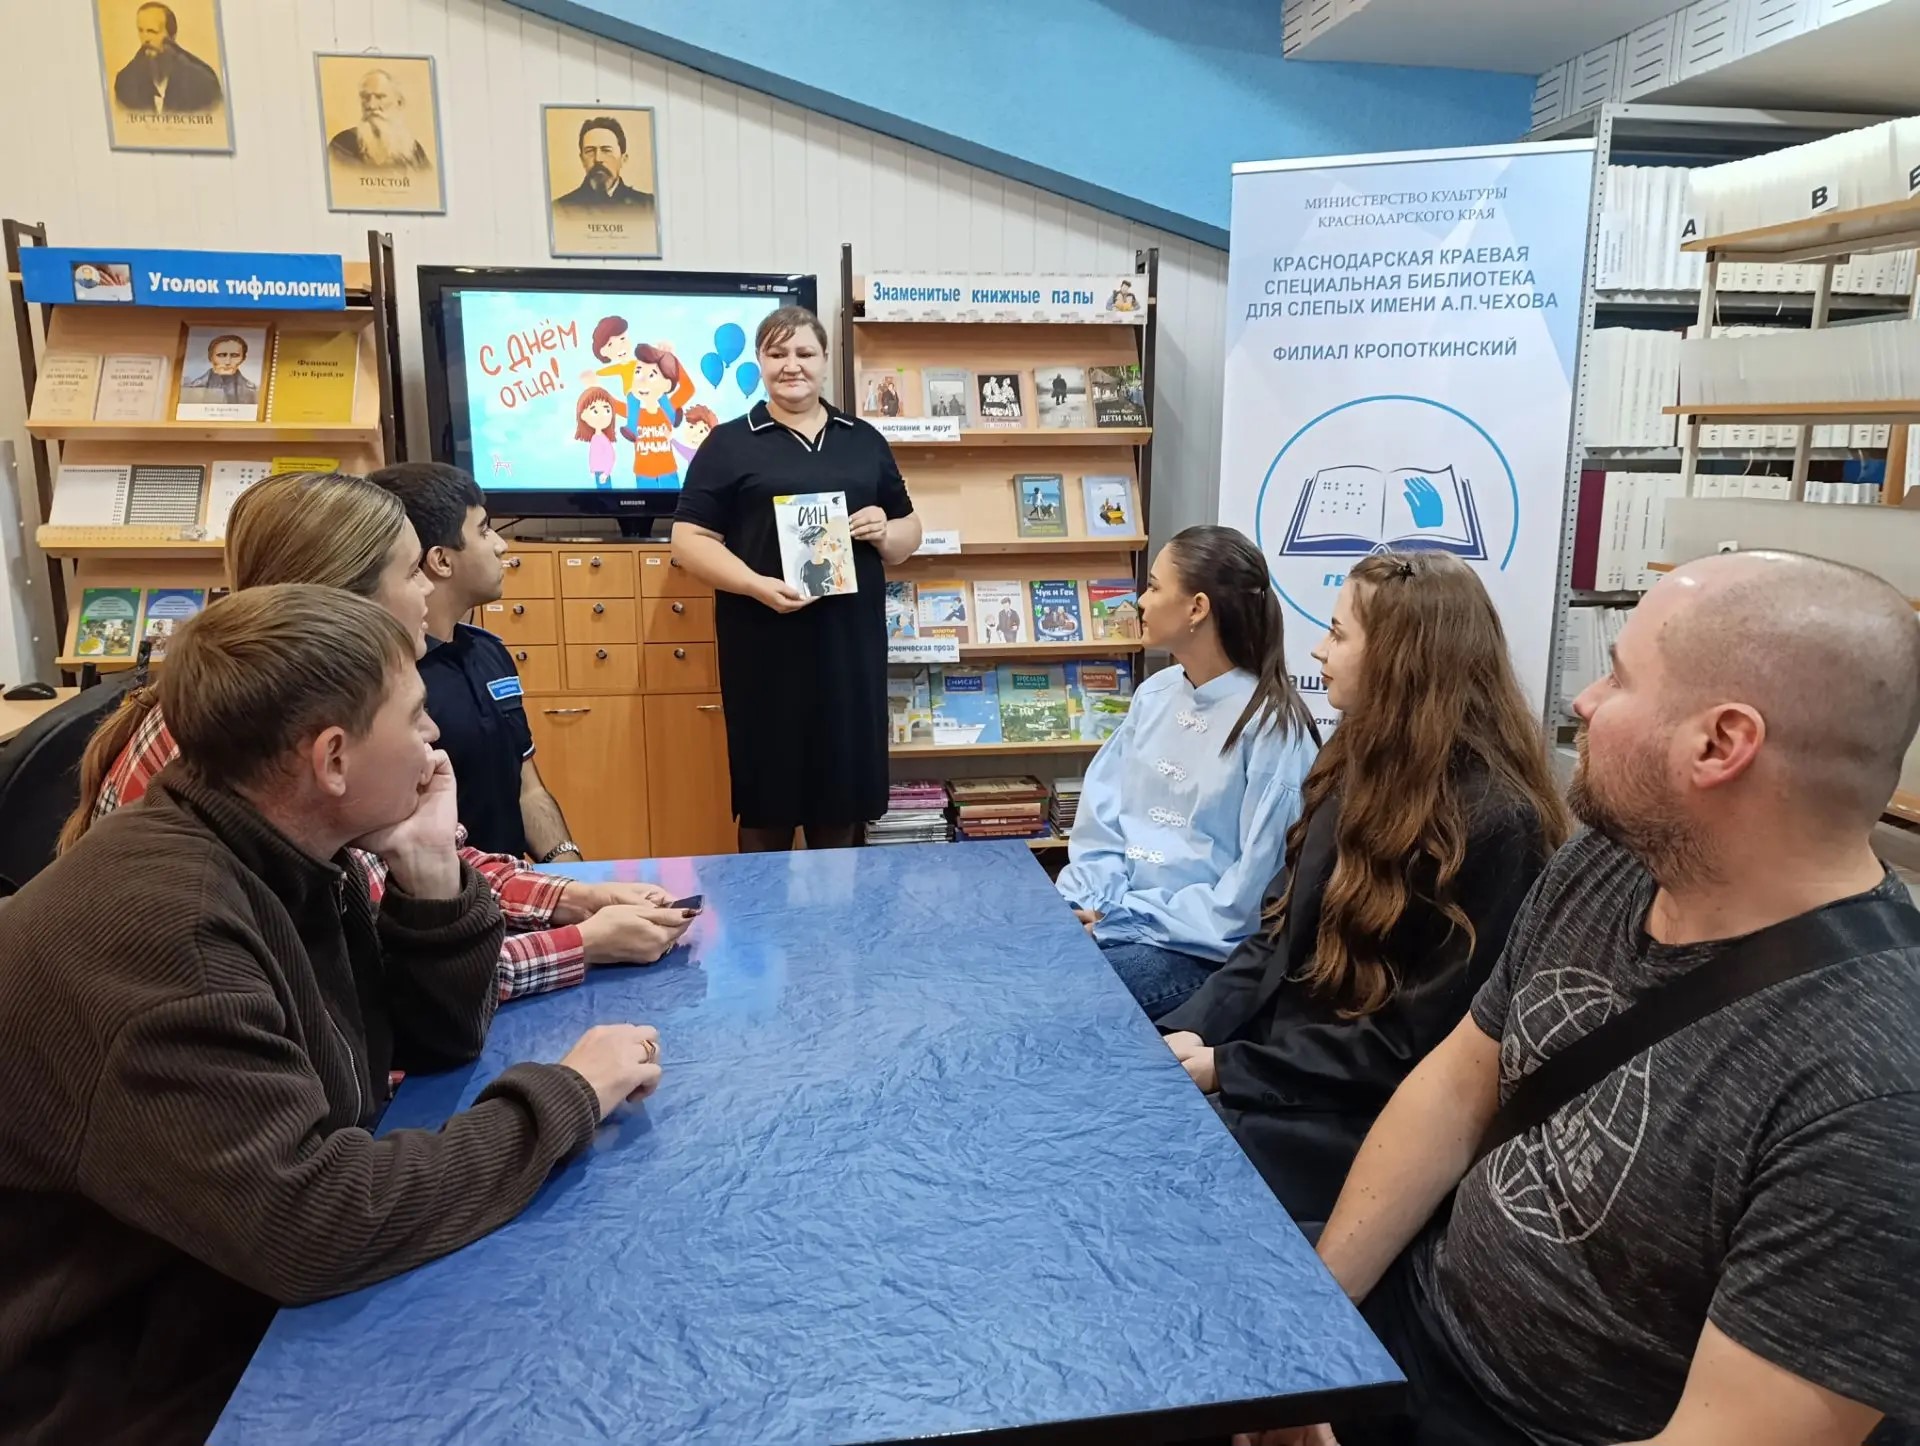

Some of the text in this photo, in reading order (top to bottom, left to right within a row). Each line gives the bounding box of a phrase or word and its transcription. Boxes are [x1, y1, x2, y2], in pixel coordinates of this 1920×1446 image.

[126, 112, 214, 125] ДОСТОЕВСКИЙ
[360, 176, 410, 187] ТОЛСТОЙ
[1304, 187, 1508, 210] МИНИСТЕРСТВО КУЛЬТУРЫ
[588, 223, 624, 232] ЧЕХОВ
[1318, 207, 1495, 228] КРАСНОДАРСКОГО КРАЯ
[1273, 246, 1529, 272] КРАСНОДАРСКАЯ КРАЕВАЯ
[148, 272, 341, 301] Уголок тифлологии
[873, 281, 961, 303] Знаменитые
[971, 287, 1041, 304] книжные
[1264, 269, 1536, 296] СПЕЦИАЛЬНАЯ БИБЛИОТЕКА
[1246, 302, 1282, 321] ДЛЯ
[1287, 298, 1365, 316] СЛЕПЫХ
[1371, 296, 1436, 313] ИМЕНИ
[1273, 336, 1517, 361] ФИЛИАЛ КРОПОТКИНСКИЙ
[480, 345, 502, 376] С
[500, 357, 564, 408] ОТЦА!
[933, 424, 952, 433] друг
[1100, 414, 1142, 423] ДЕТИ МОИ
[1035, 588, 1051, 598] Чук
[1060, 587, 1075, 596] Гек
